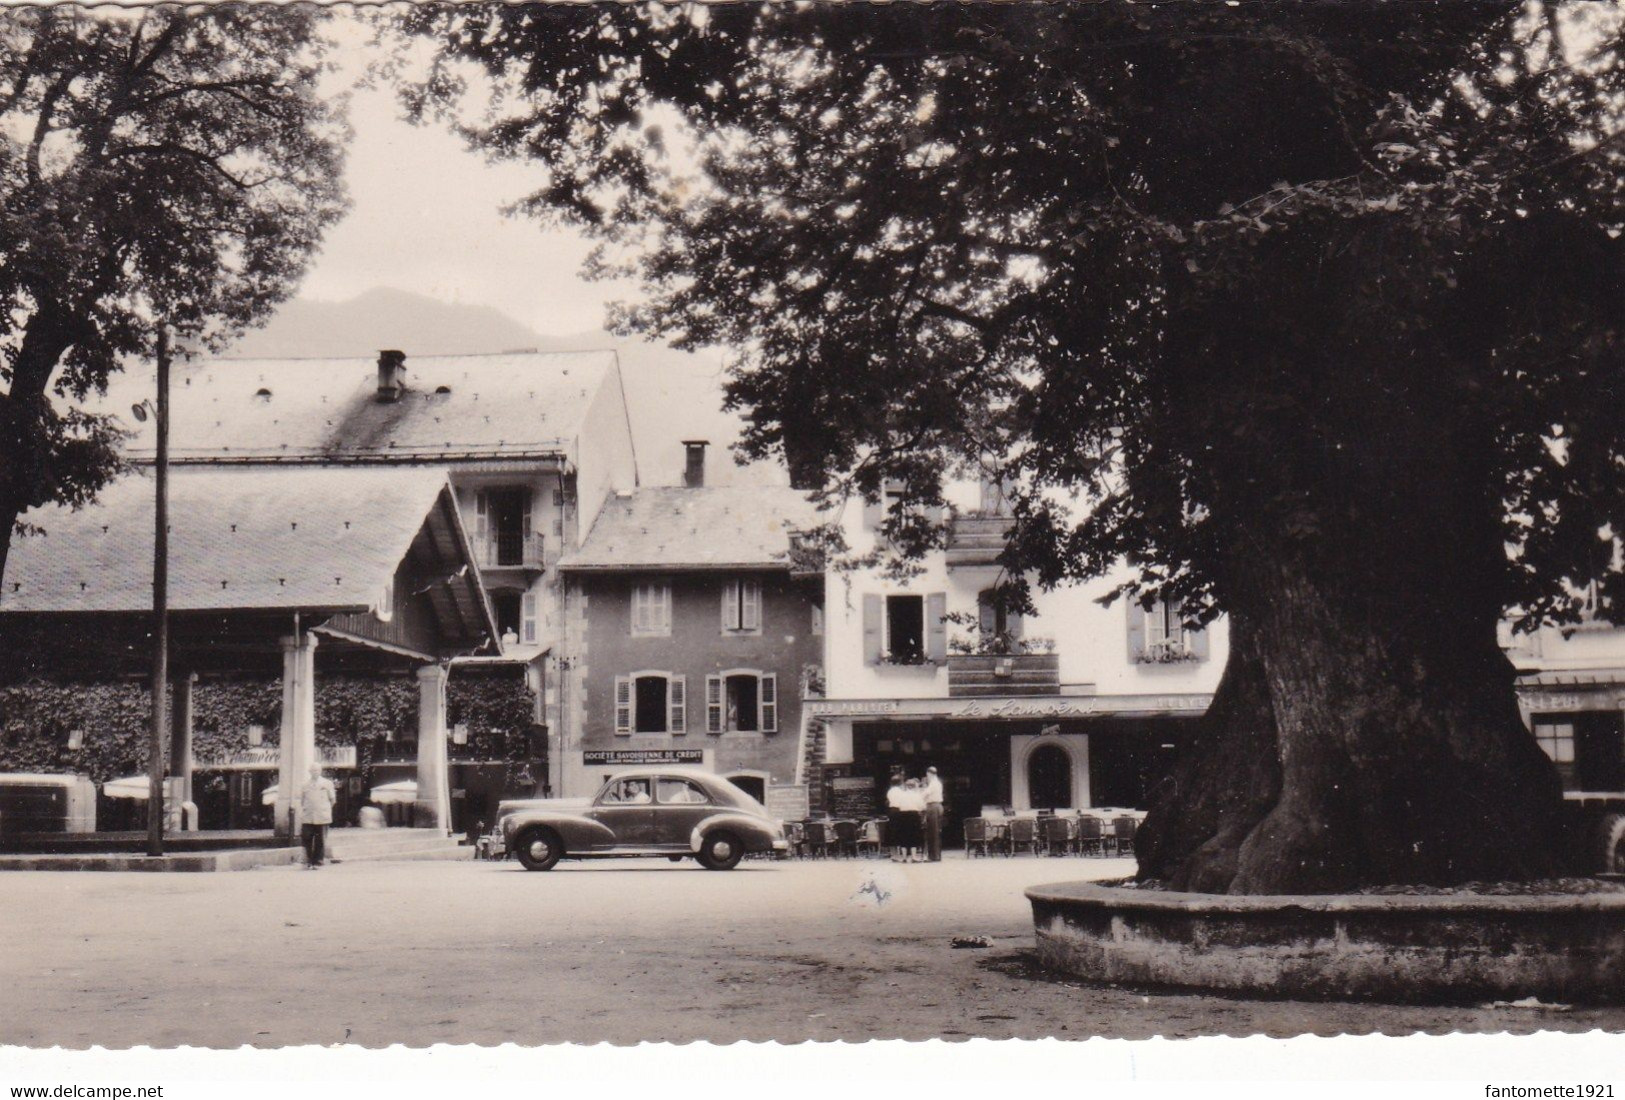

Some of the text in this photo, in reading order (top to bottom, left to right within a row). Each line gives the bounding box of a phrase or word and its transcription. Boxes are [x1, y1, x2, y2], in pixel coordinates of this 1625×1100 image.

[956, 698, 984, 716] Le
[584, 749, 702, 760] SOCIÉTÉ SAVOISIENNE DE CRÉDIT
